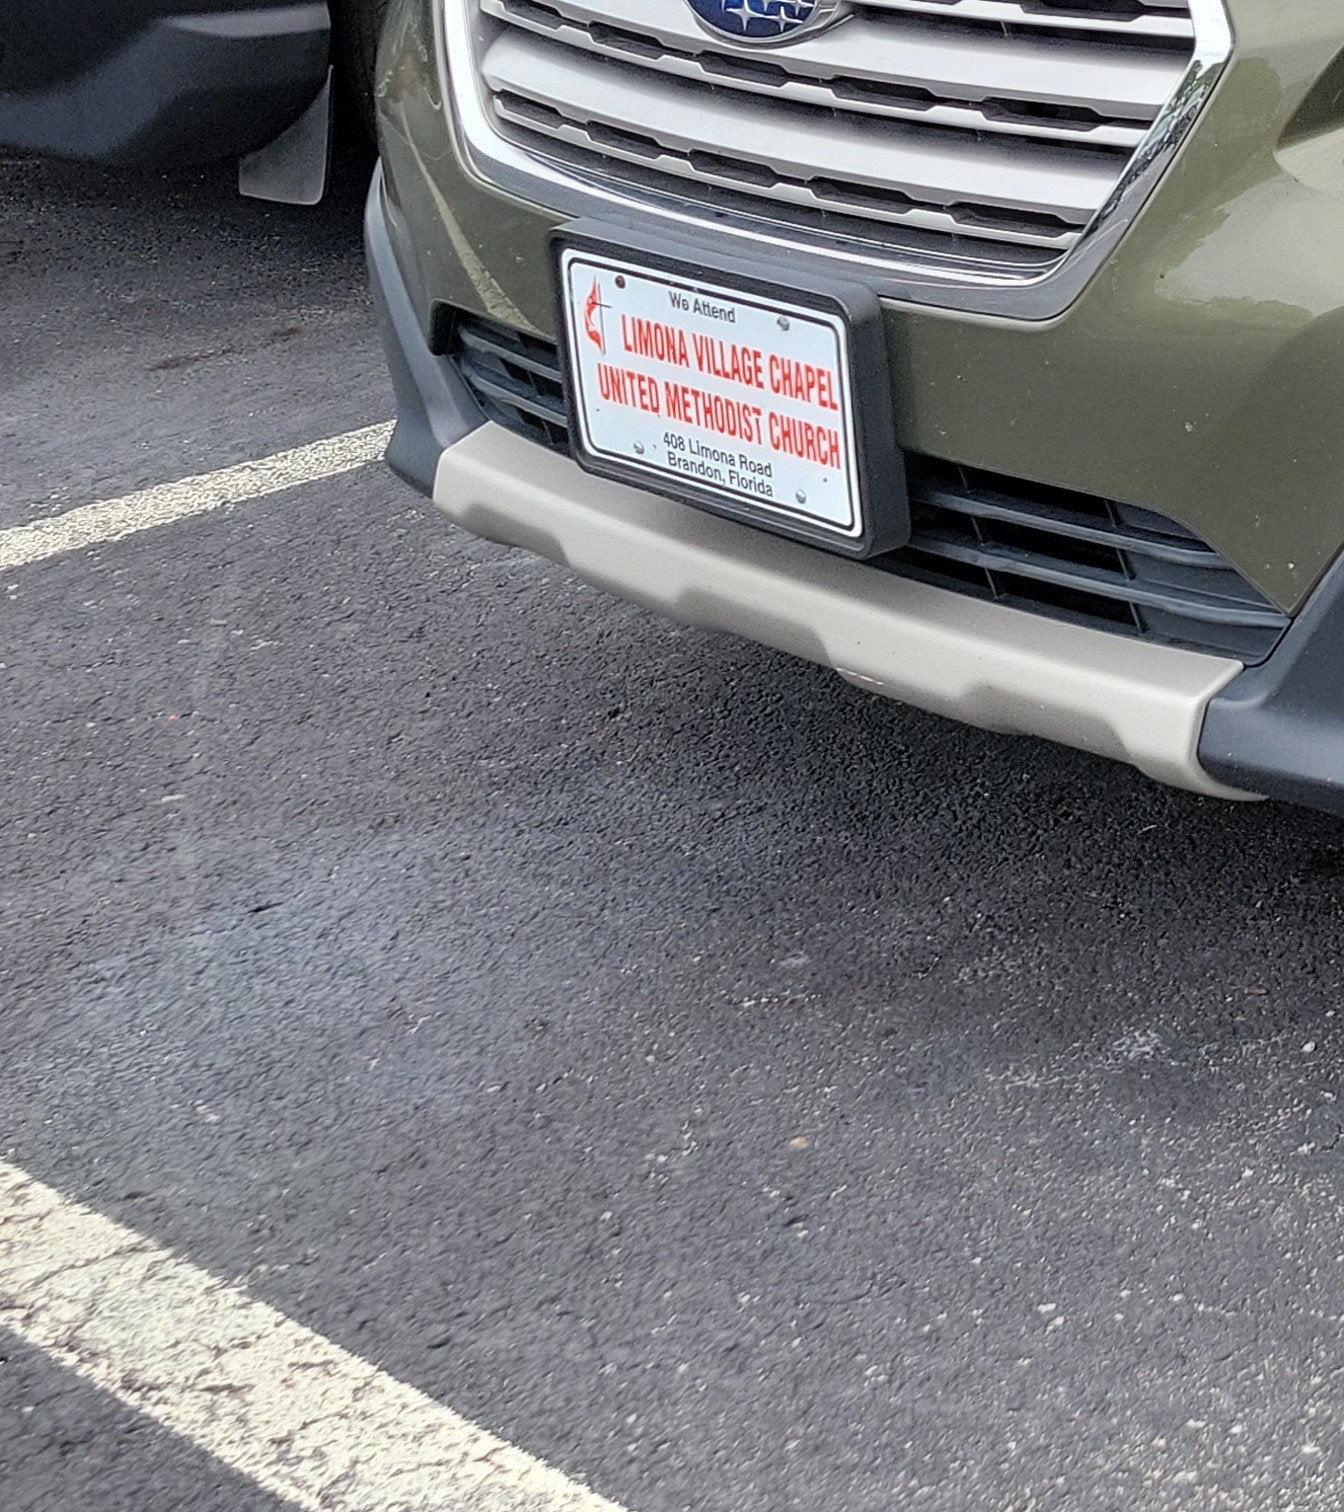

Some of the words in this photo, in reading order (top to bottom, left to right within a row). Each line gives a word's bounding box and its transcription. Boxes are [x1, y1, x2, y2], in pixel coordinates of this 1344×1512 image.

[668, 291, 690, 311] We
[692, 299, 736, 324] Attend
[620, 313, 690, 369] LIMONA
[691, 332, 765, 390] VILLAGE
[768, 354, 839, 412] CHAPEL
[597, 362, 660, 414] UNITED
[663, 380, 763, 446] METHODIST
[768, 410, 842, 471] CHURCH
[662, 431, 686, 452] 408
[688, 437, 736, 468] Limona
[738, 453, 773, 478] Road
[666, 451, 726, 486] Brandon,
[728, 467, 774, 498] Florida
